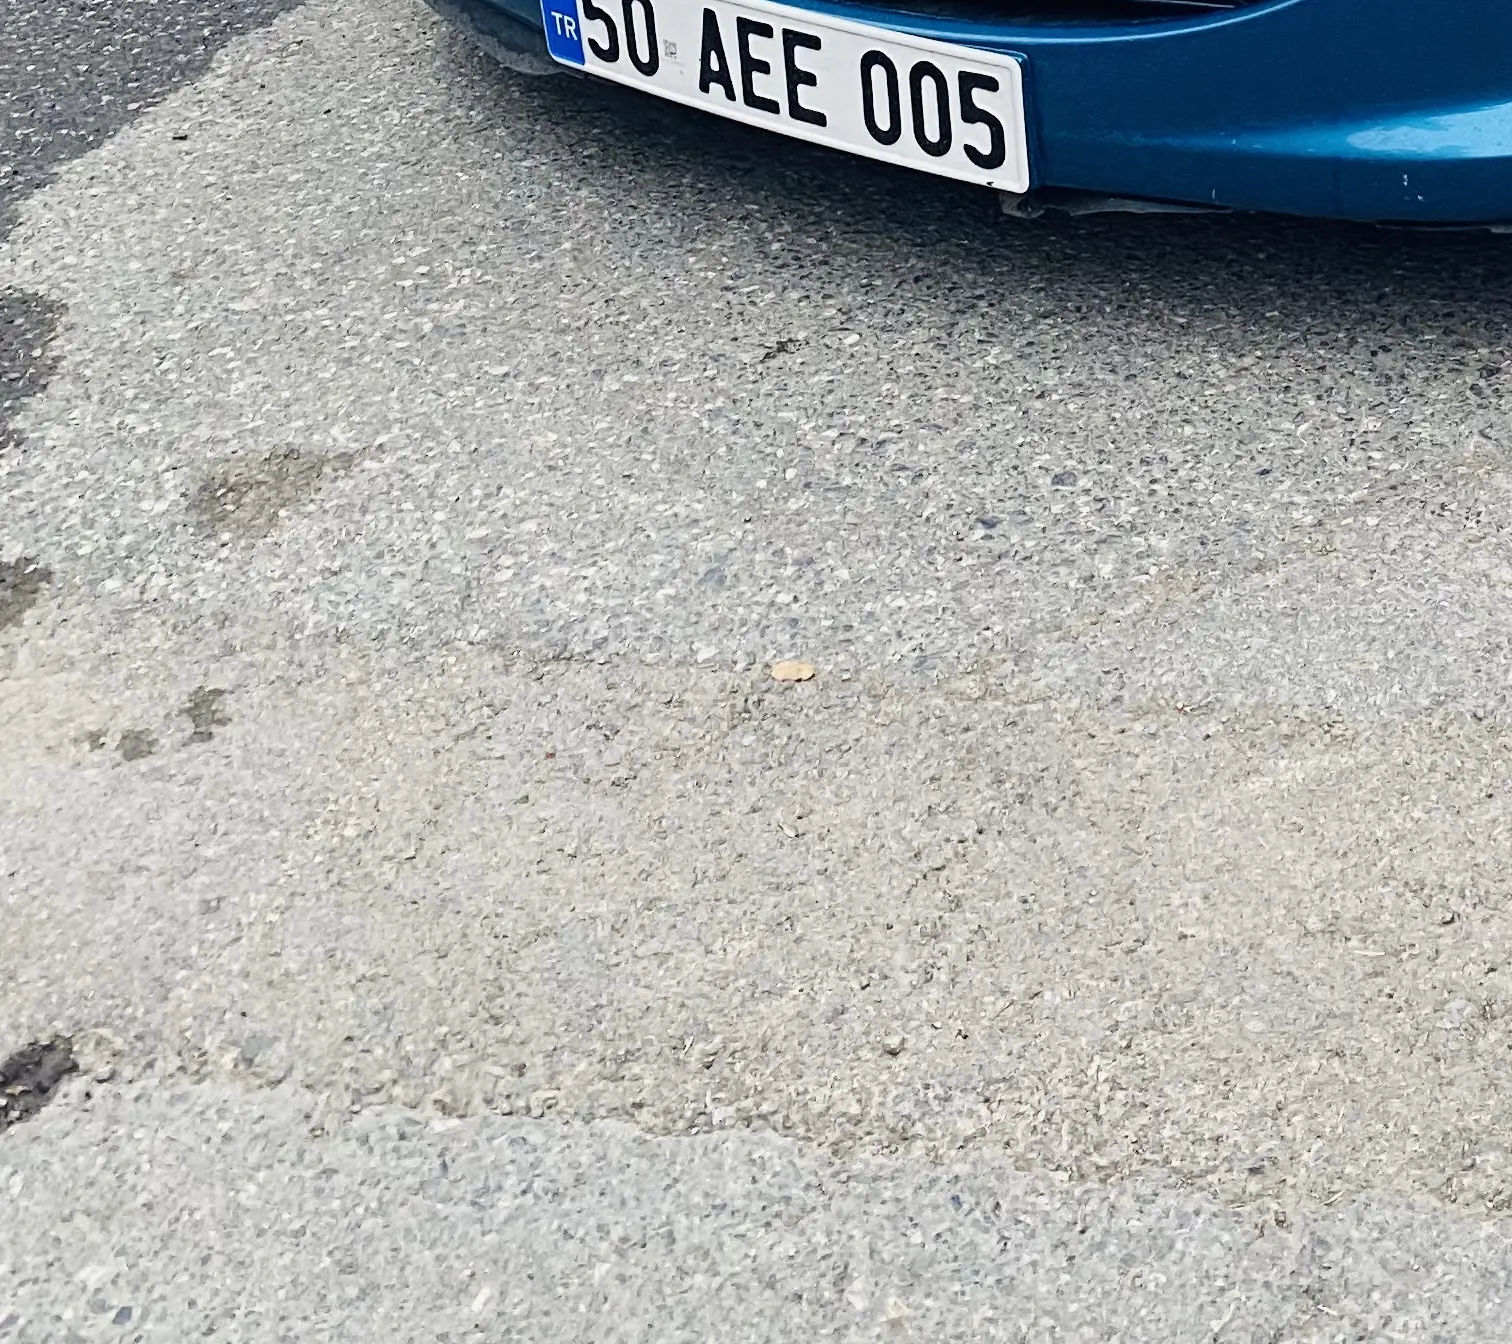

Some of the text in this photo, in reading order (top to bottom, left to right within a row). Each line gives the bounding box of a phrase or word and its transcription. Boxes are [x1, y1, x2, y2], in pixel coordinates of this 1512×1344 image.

[550, 10, 579, 41] TR
[699, 7, 828, 128] AEE
[860, 49, 1007, 170] 005
